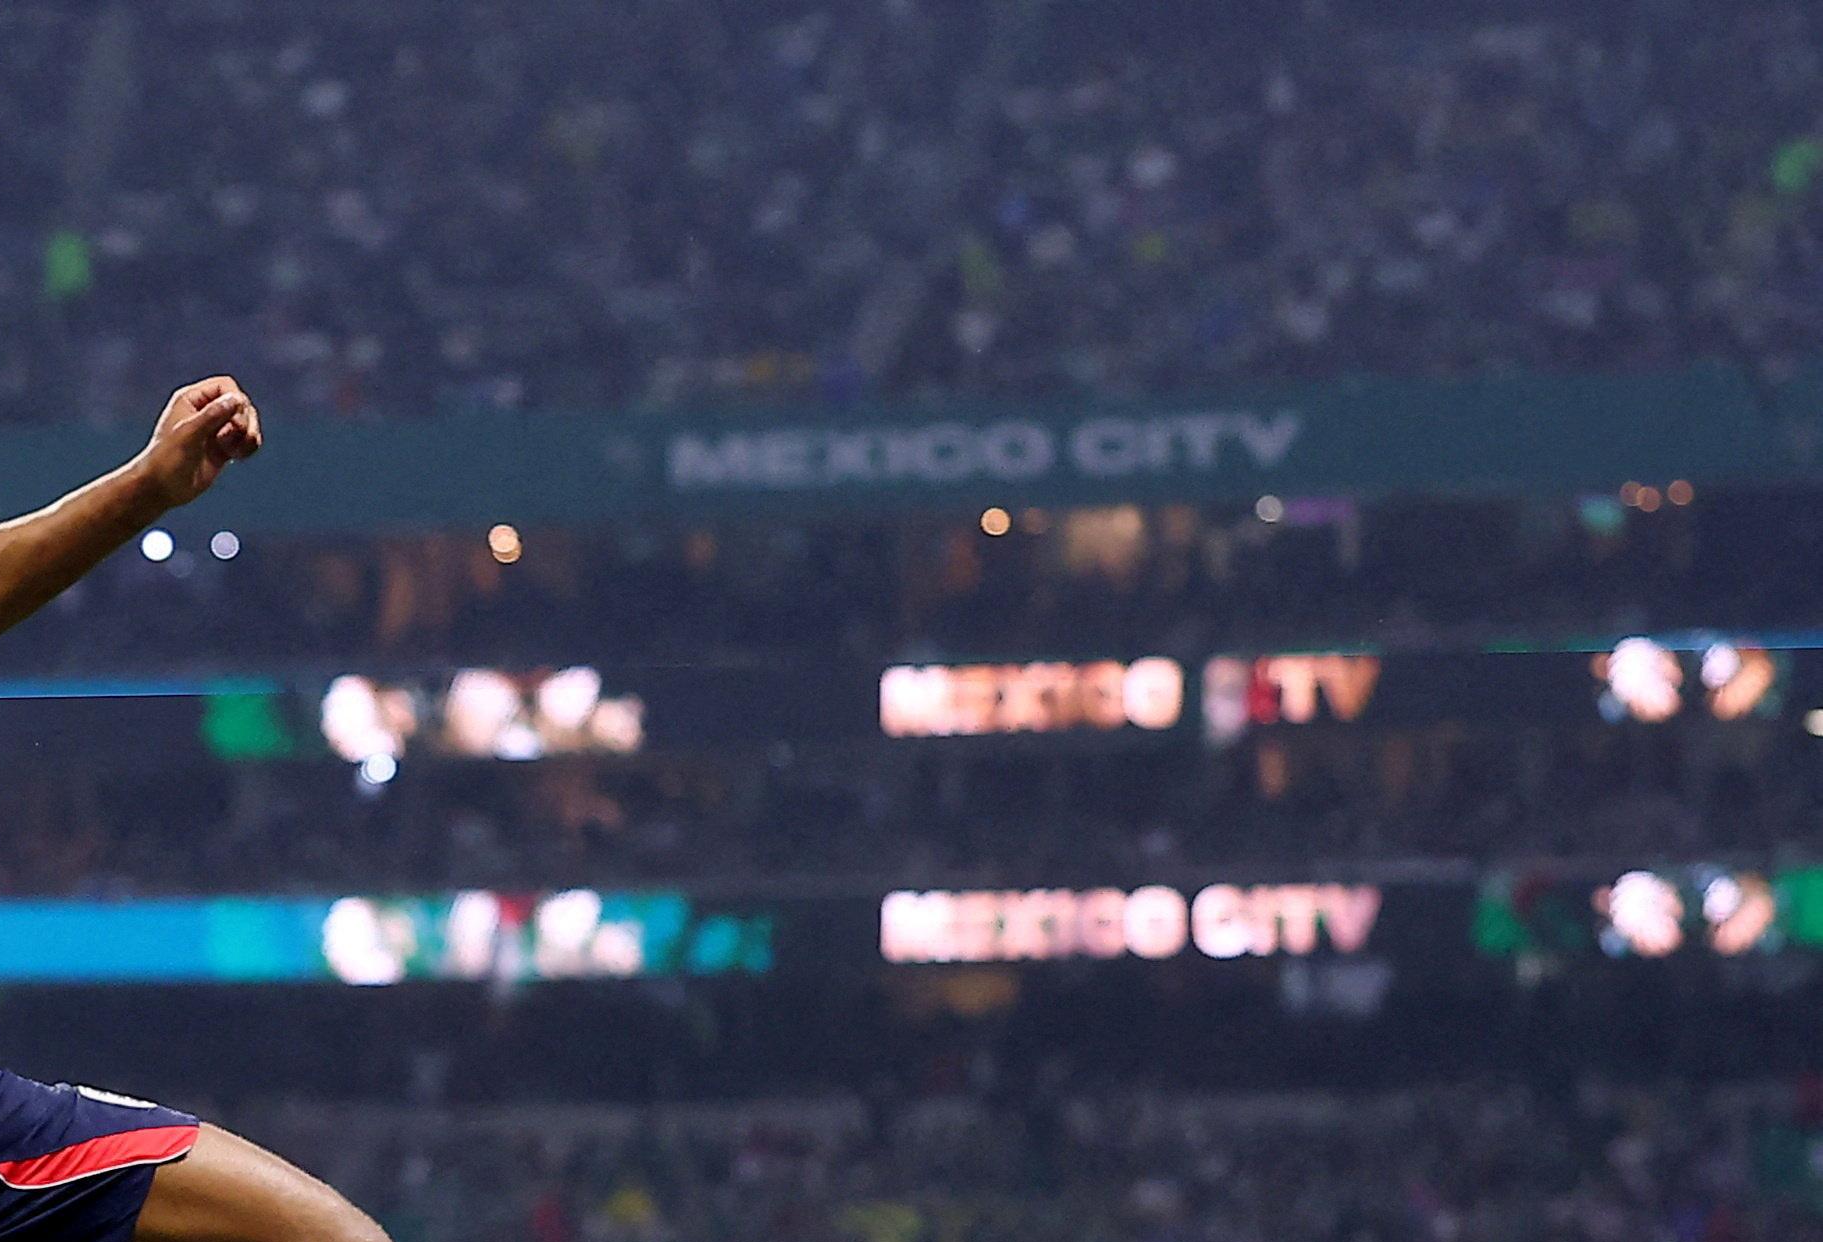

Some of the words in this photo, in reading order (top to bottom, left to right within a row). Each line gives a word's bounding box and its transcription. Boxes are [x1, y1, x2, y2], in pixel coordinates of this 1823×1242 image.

[670, 423, 1052, 487] MEXICO
[1074, 411, 1302, 479] CITY
[879, 886, 1189, 963] MEXICO
